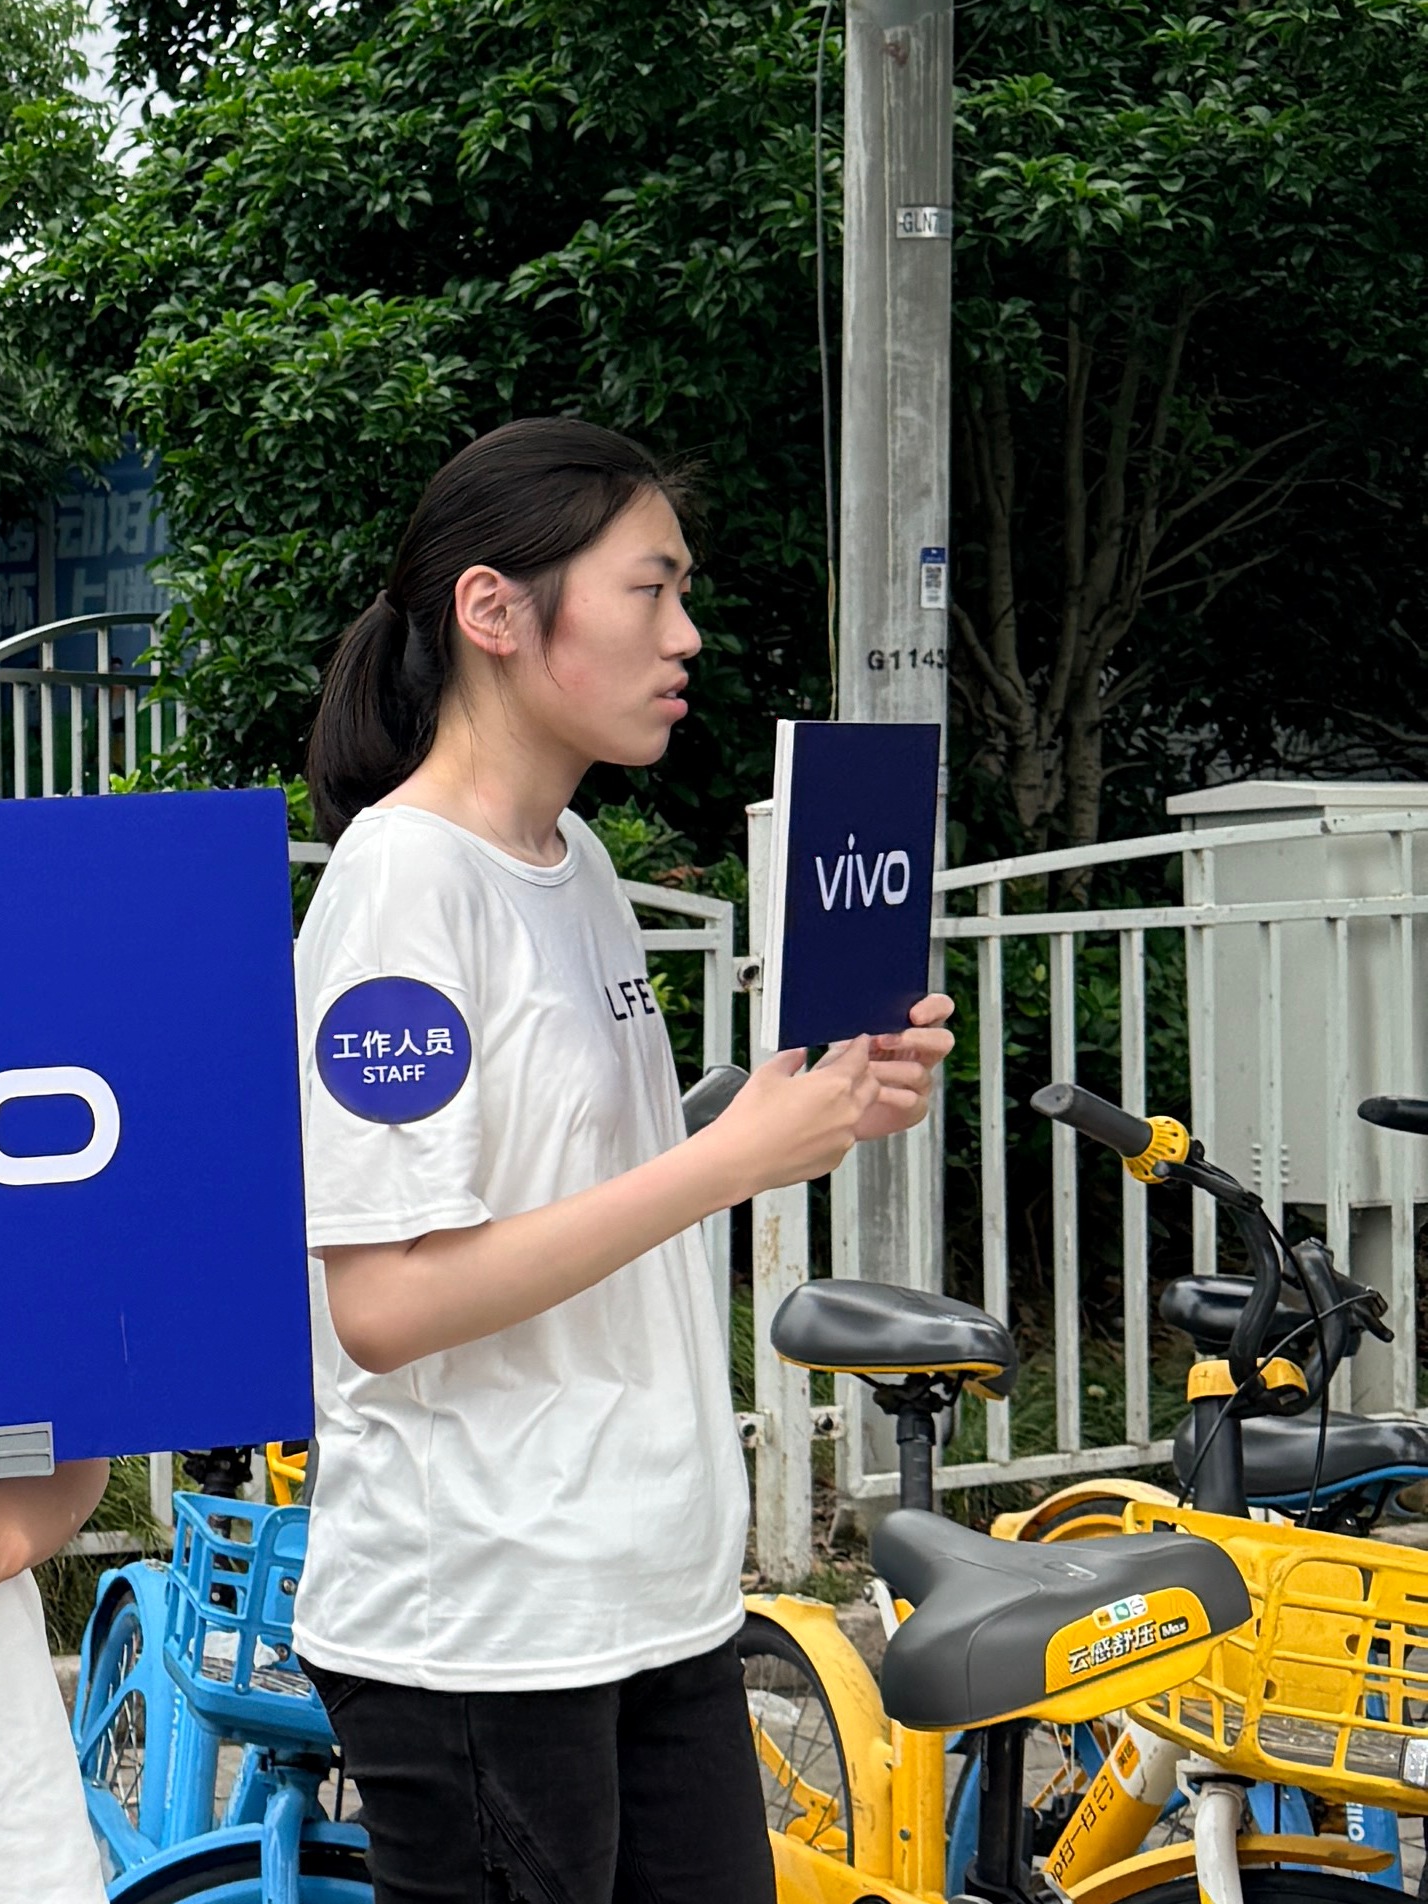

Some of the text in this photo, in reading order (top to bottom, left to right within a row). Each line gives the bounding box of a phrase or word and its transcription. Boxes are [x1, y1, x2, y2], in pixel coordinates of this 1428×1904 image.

[815, 832, 910, 911] vivo
[604, 978, 655, 1021] LFE
[332, 1028, 454, 1059] 工作人员
[363, 1063, 426, 1084] STAFF
[1068, 1620, 1156, 1674] 云感舒压
